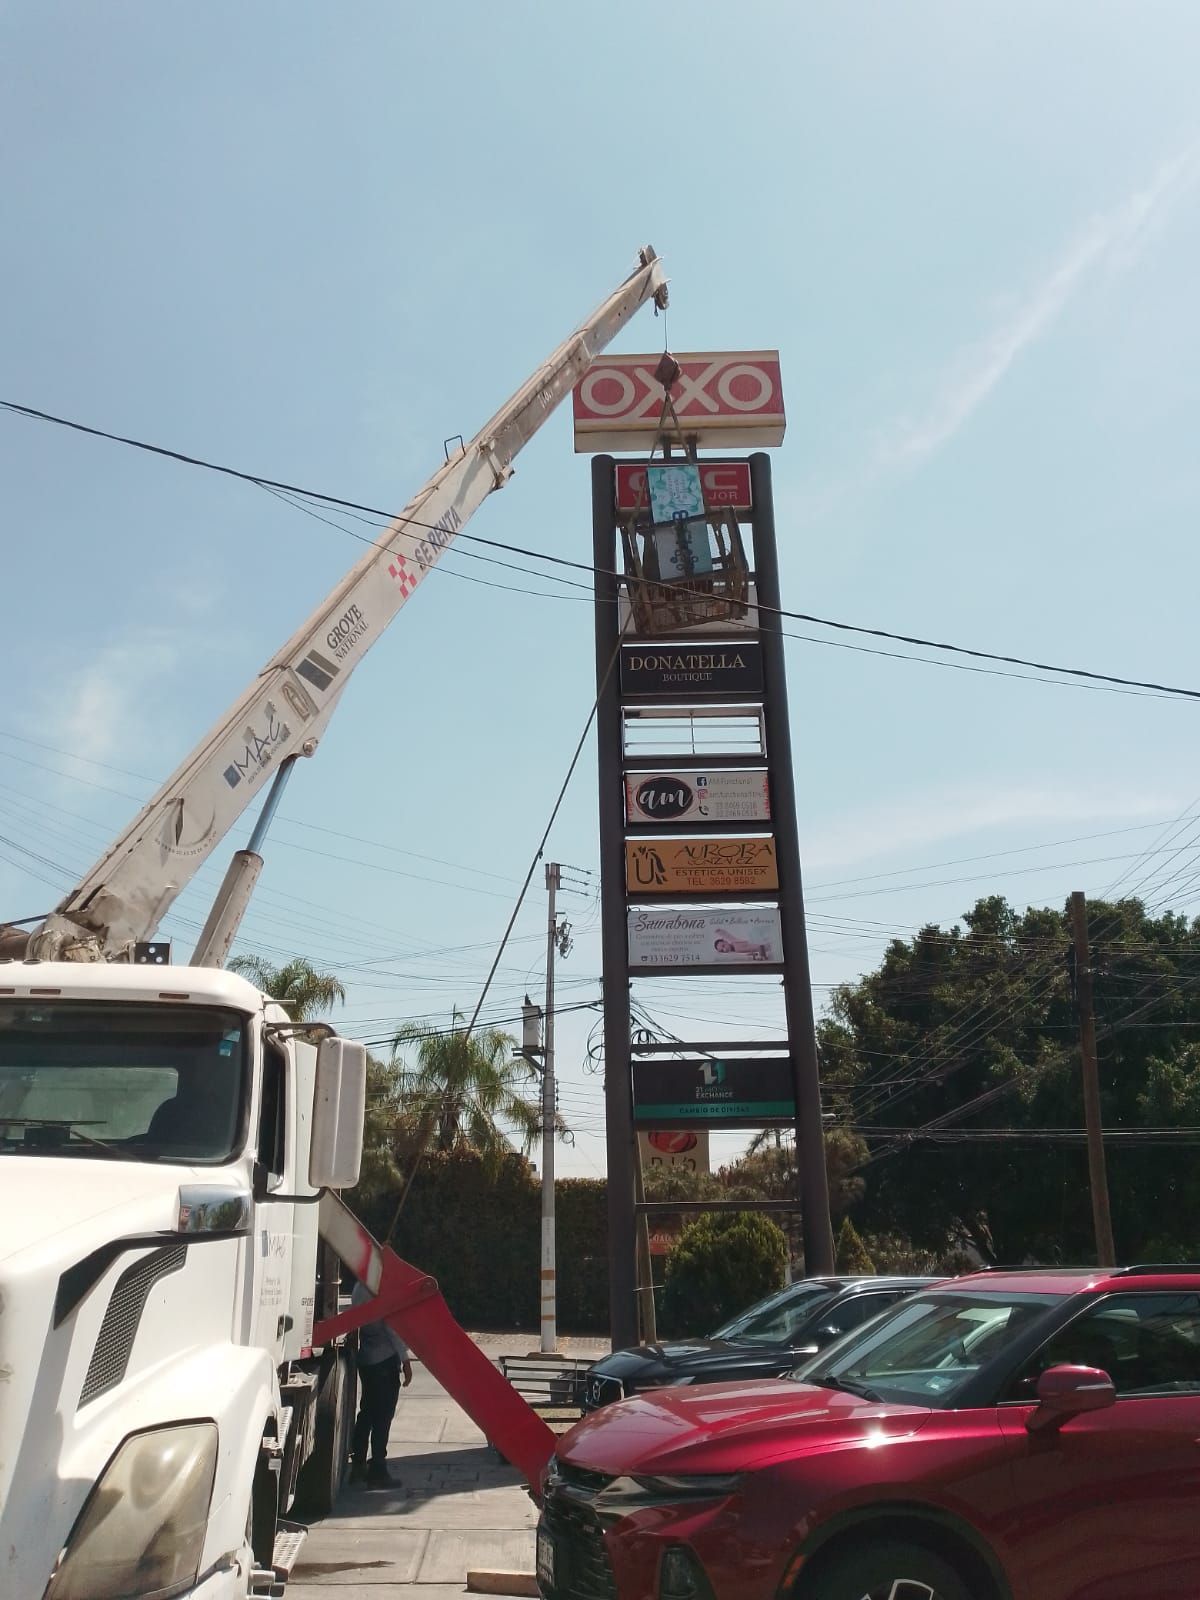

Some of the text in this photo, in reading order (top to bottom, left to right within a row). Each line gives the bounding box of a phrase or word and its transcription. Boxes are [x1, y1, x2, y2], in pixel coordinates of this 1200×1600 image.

[580, 362, 773, 417] OXXO
[414, 505, 462, 570] SE RENTA
[326, 604, 363, 650] GROVE
[335, 620, 369, 662] NATIONAL
[629, 654, 747, 671] DONATELLA
[662, 672, 712, 682] BOUTIQUE
[233, 715, 281, 778] MAC
[673, 843, 773, 859] AURORA
[727, 868, 767, 876] UNISEX
